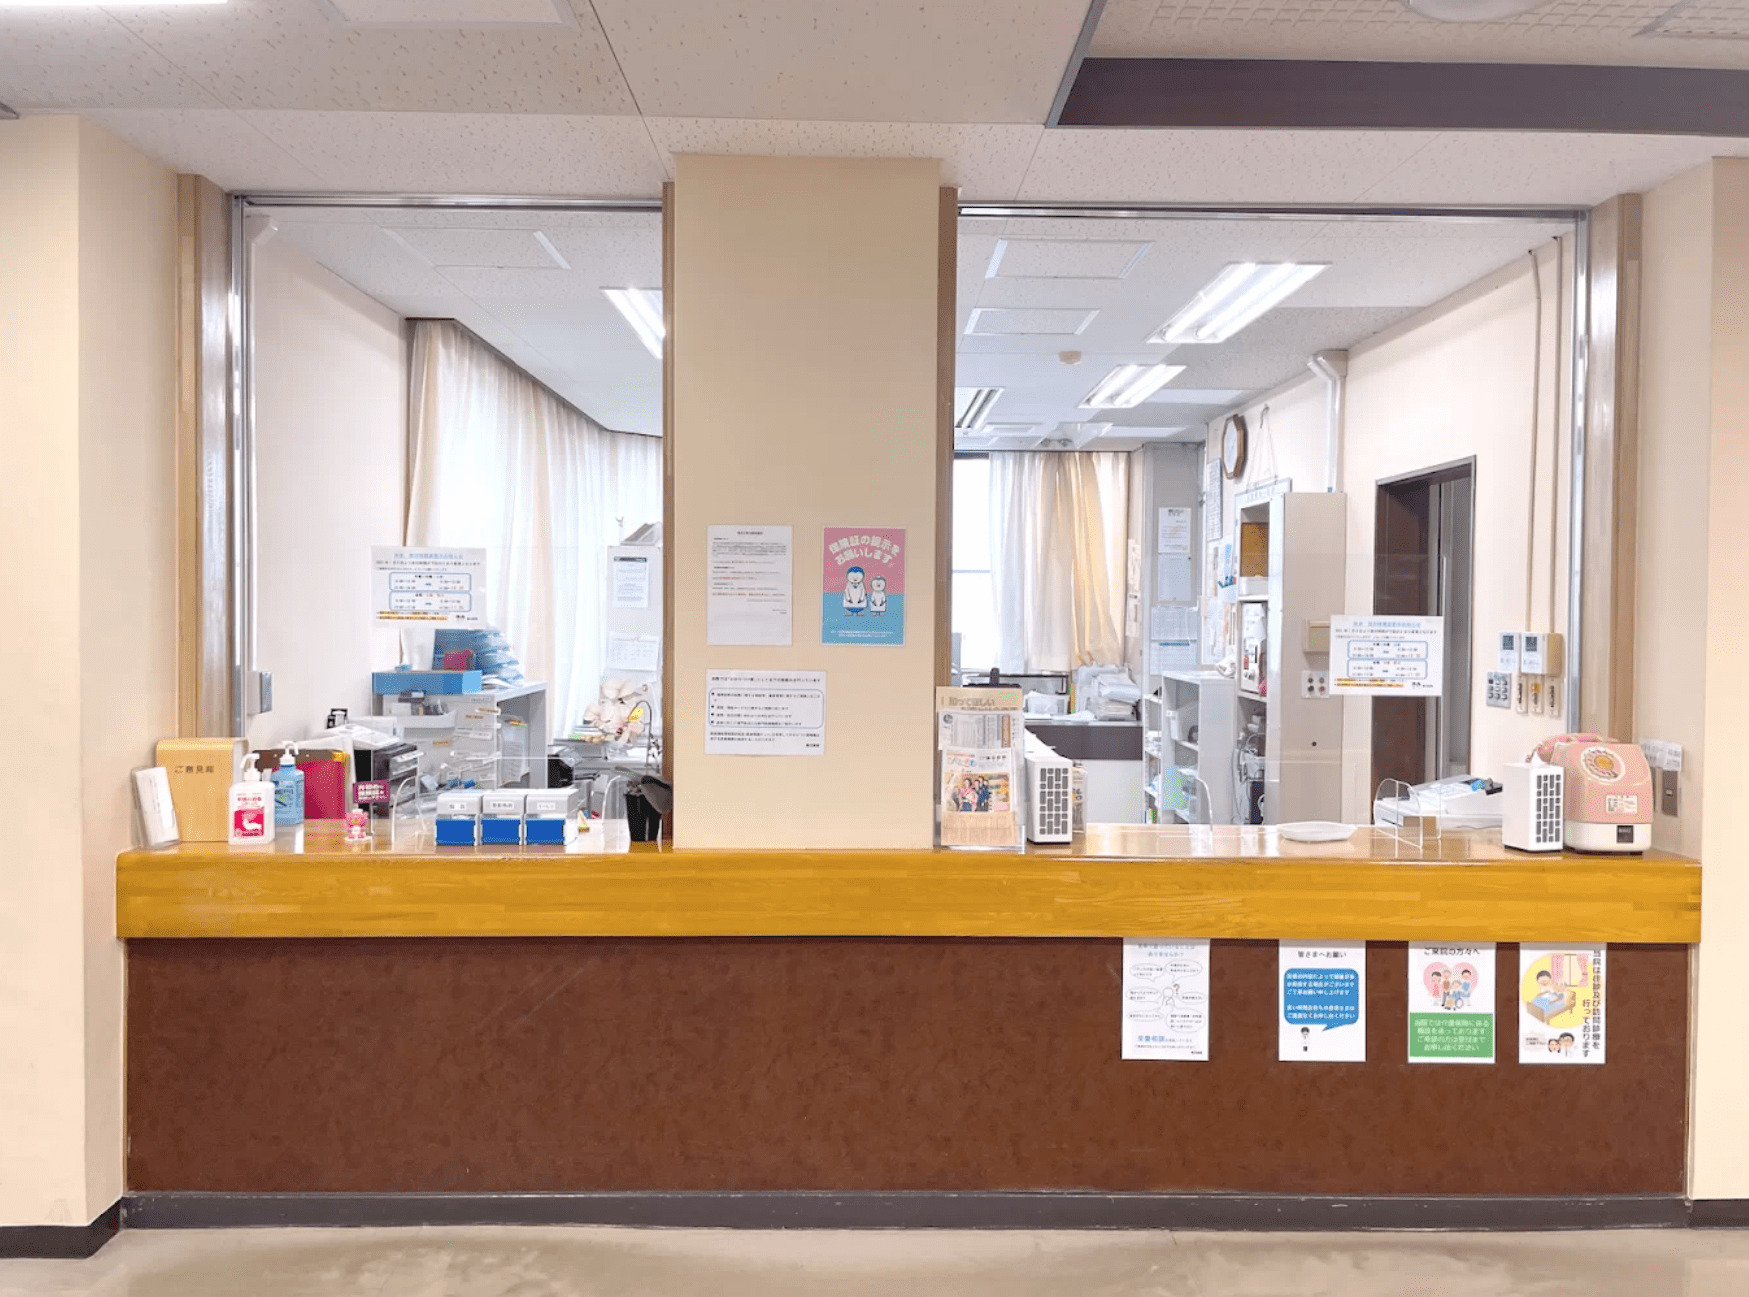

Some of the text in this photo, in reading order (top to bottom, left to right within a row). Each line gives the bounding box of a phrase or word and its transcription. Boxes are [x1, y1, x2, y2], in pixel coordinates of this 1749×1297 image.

[828, 535, 900, 556] 保険証の提示を
[835, 547, 893, 565] お願いします
[174, 765, 214, 774] ご意見箱
[1423, 947, 1480, 956] ご来院の方々へ
[1582, 999, 1591, 1058] 行っております
